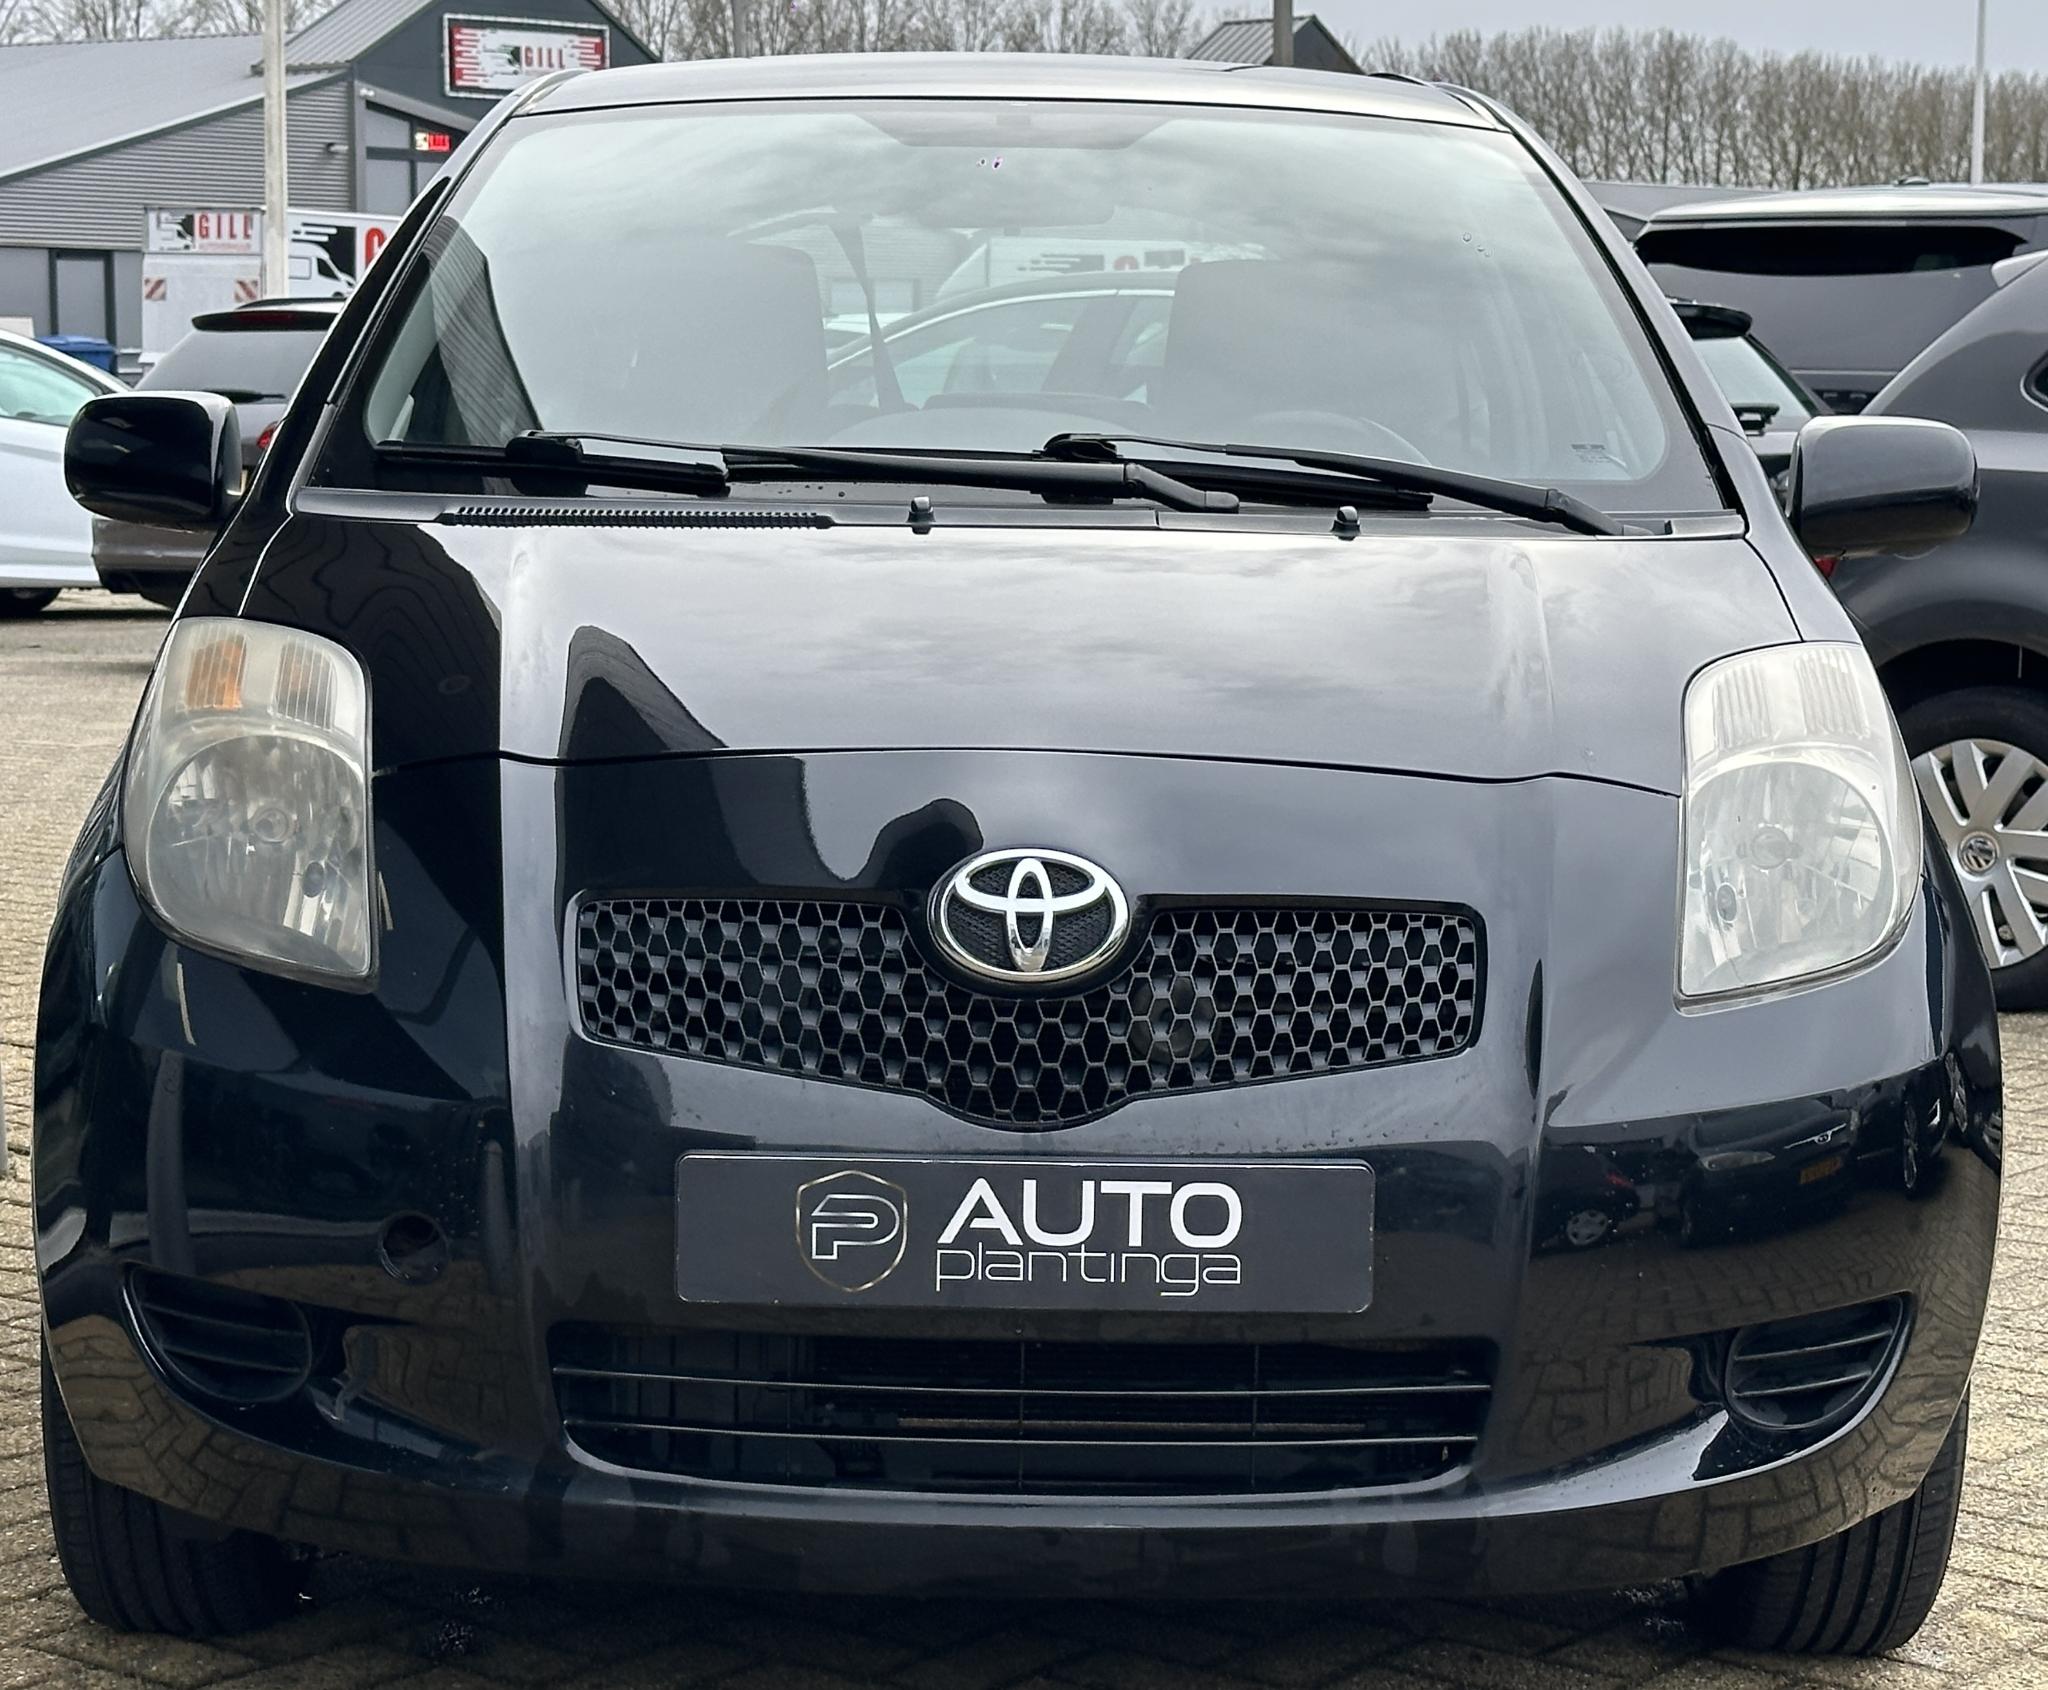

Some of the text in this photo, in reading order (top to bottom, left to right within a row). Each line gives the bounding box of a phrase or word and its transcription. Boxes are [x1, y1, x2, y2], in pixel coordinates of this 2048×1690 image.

[524, 46, 565, 69] GILL
[199, 213, 251, 239] GILL
[937, 1176, 1243, 1248] AUTO
[936, 1241, 1242, 1297] plantinga
